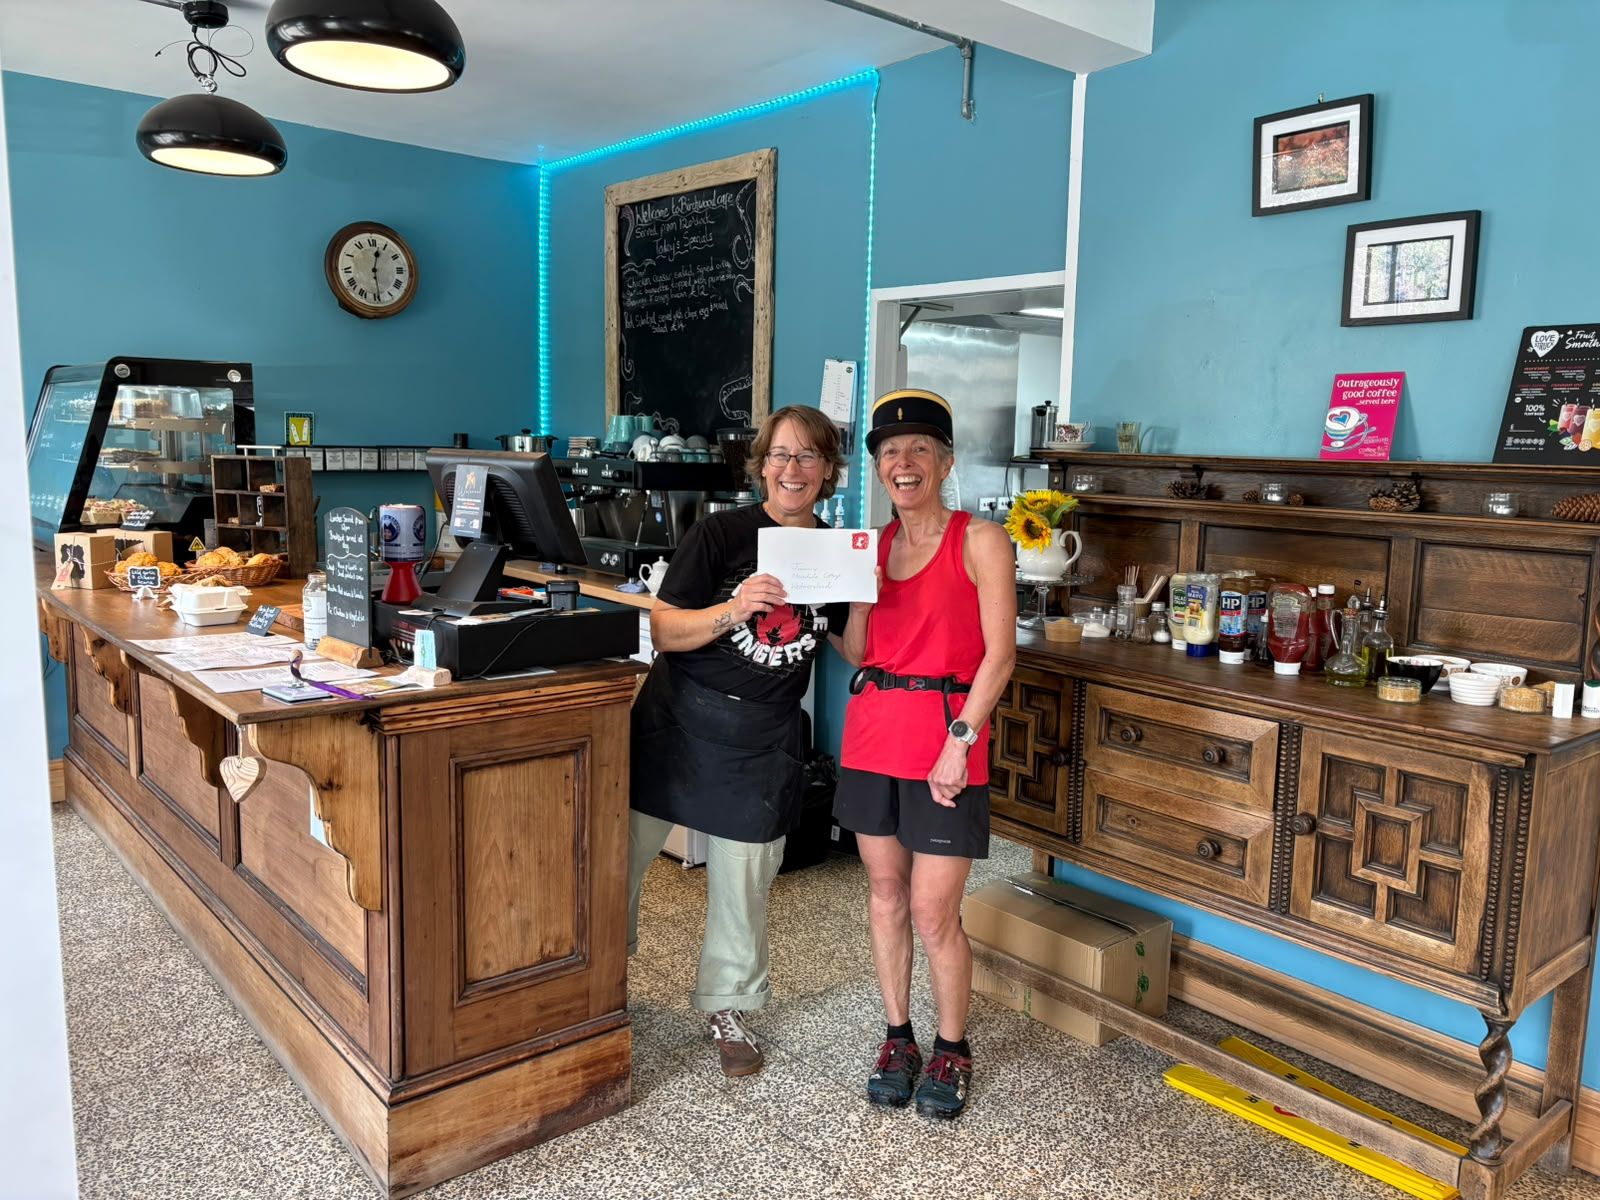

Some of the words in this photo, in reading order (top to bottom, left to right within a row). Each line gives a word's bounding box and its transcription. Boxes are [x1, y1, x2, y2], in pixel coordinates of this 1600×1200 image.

[635, 223, 659, 239] Served
[1575, 330, 1596, 339] Fruit
[1565, 337, 1600, 349] Smooth
[1336, 377, 1400, 389] Outrageously
[1342, 390, 1365, 401] good
[1366, 388, 1398, 398] coffee
[1525, 404, 1545, 412] 100%
[1188, 592, 1204, 600] MAYO
[1222, 597, 1240, 609] HP
